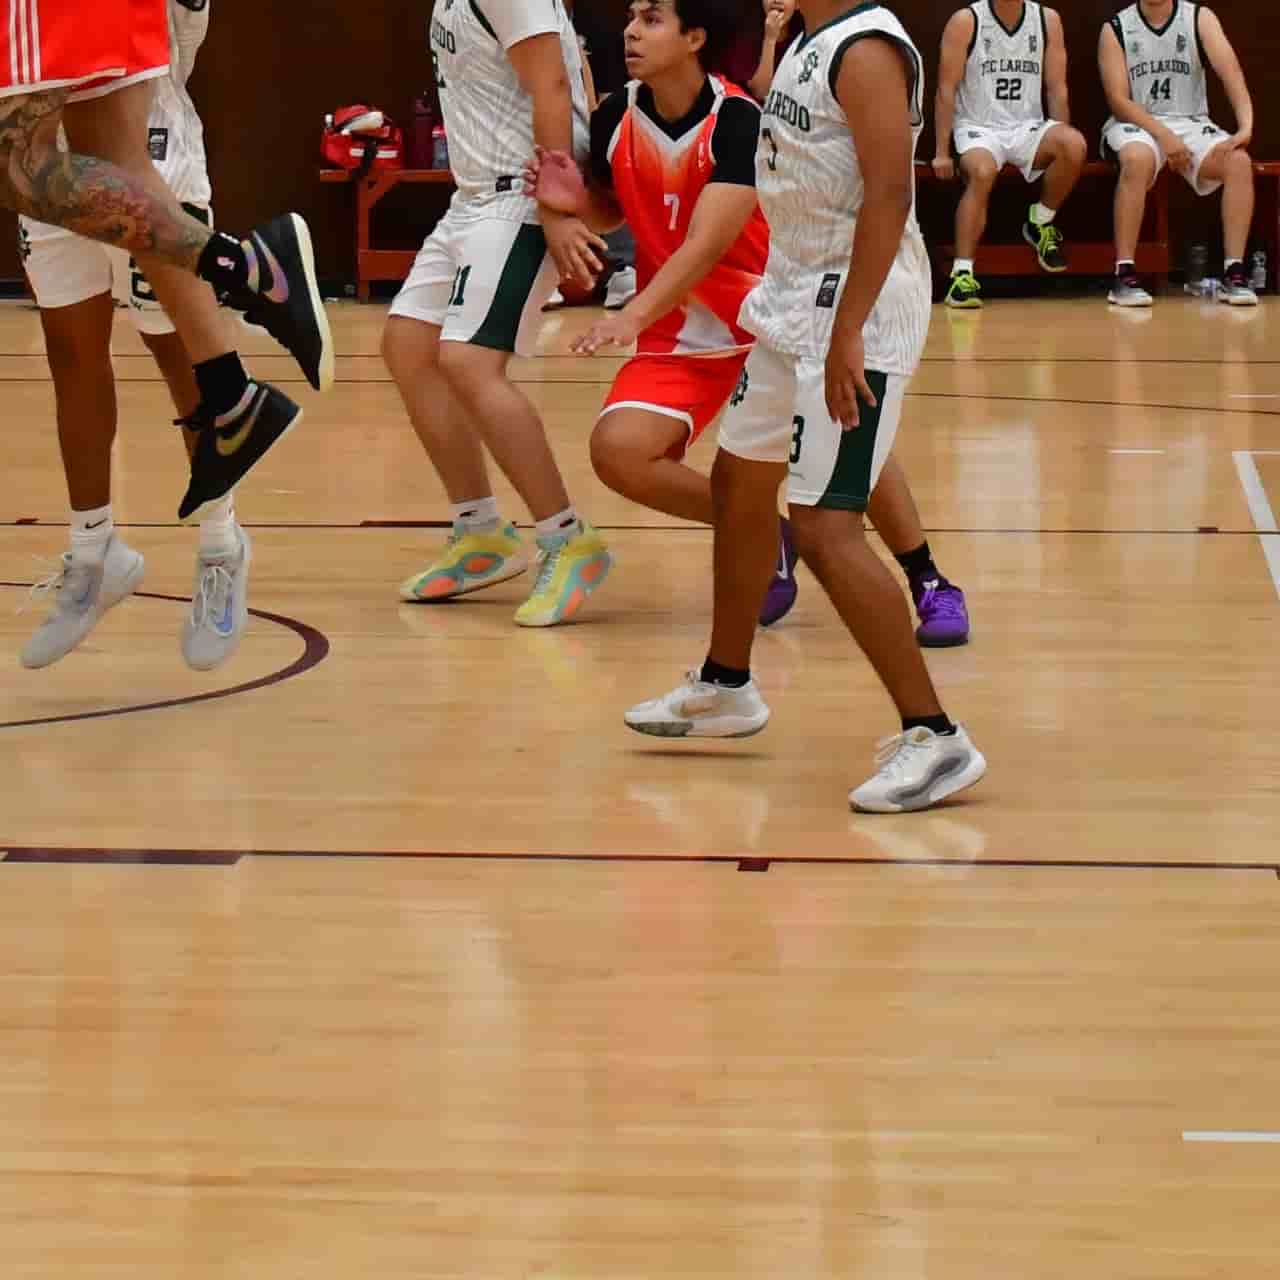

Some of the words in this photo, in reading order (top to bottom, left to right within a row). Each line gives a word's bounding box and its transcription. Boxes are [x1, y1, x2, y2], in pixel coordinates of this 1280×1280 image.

[982, 60, 997, 77] TEC
[999, 59, 1040, 75] LAREDO
[1130, 62, 1149, 81] TEC
[1150, 59, 1190, 75] LAREDO
[995, 78, 1022, 100] 22
[663, 192, 680, 231] 7
